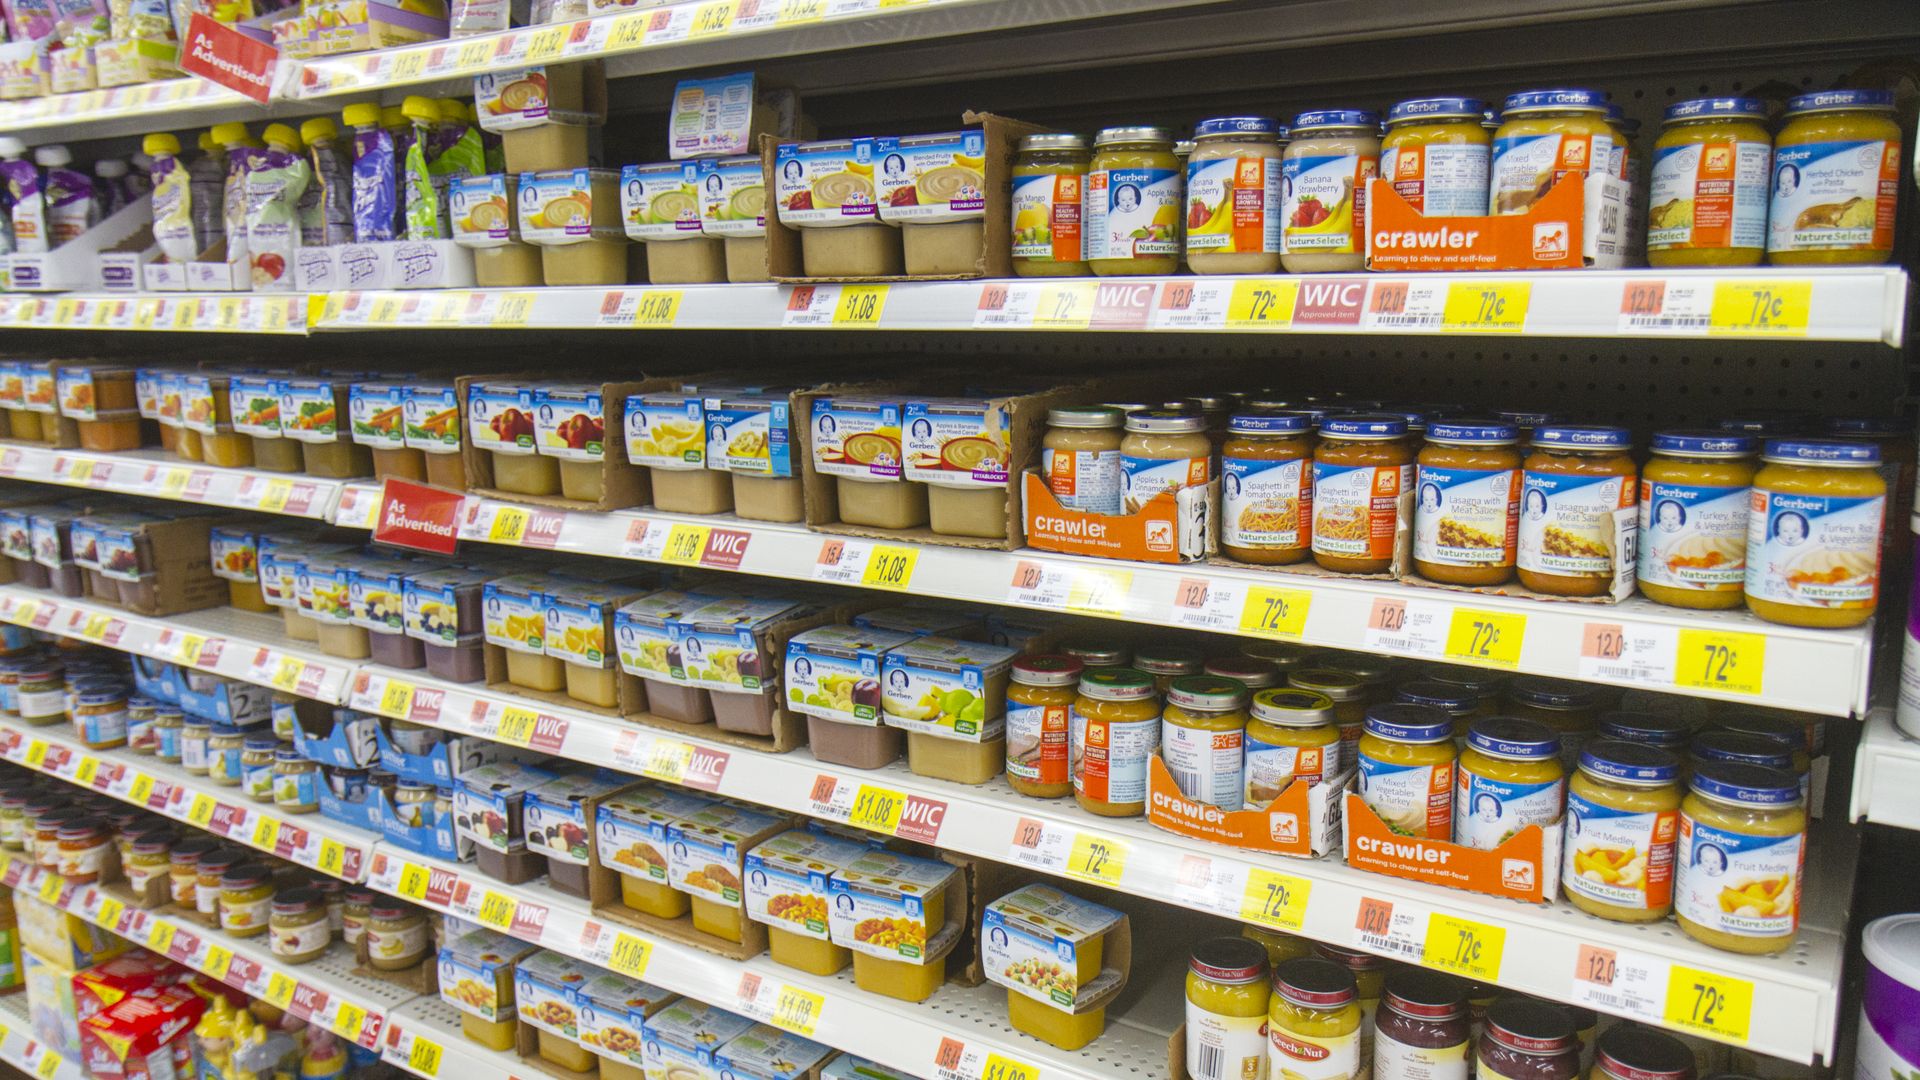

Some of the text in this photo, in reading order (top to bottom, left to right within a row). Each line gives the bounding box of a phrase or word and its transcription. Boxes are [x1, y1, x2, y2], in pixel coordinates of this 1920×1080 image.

[194, 33, 213, 50] As
[191, 47, 267, 88] Advertised
[1556, 93, 1590, 104] Gerber
[1815, 94, 1855, 105] Gerber
[1407, 103, 1440, 113] Gerber
[937, 152, 951, 160] Fruits
[1505, 153, 1529, 163] Mixed
[1777, 151, 1811, 162] Gerber
[1113, 173, 1149, 182] Gerber
[1806, 168, 1864, 178] Herbed Chicken
[882, 178, 910, 187] Gerber
[1303, 176, 1331, 185] Banana
[1699, 181, 1730, 189] NUTRITION
[1824, 178, 1844, 187] Pasta
[782, 183, 807, 192] Gerber
[1298, 184, 1339, 195] Strawberry
[1709, 187, 1730, 195] BABIES
[1374, 226, 1480, 249] crawler
[1374, 254, 1497, 264] Learning to chew and self-feed
[1101, 286, 1149, 308] WIC
[1303, 283, 1361, 308] WIC
[846, 294, 877, 320] $1.08
[1249, 290, 1276, 321] 72¢
[1477, 291, 1506, 321] 72¢
[1750, 291, 1783, 323] 72¢
[1300, 310, 1355, 320] Approved item
[708, 413, 734, 424] Gerber
[1242, 420, 1270, 429] Gerber
[1515, 416, 1545, 425] Gerber
[956, 422, 979, 431] Bananas
[1330, 423, 1358, 432] Gerber
[1434, 427, 1462, 437] Gerber
[816, 436, 839, 445] Gerber
[1572, 433, 1608, 443] Gerber
[909, 440, 936, 451] Gerber
[1702, 441, 1737, 451] Gerber
[1797, 448, 1840, 460] Gerber
[1223, 461, 1248, 472] Gerber
[1136, 475, 1158, 484] Apples
[1420, 470, 1452, 482] Gerber
[1525, 475, 1558, 489] Gerber
[1247, 481, 1290, 492] Spaghetti in
[1320, 487, 1359, 498] Spaghetti in
[1655, 485, 1698, 499] Gerber
[1244, 490, 1294, 499] Tomato Sauce
[1319, 494, 1363, 506] Tomato Sauce
[389, 498, 405, 513] As
[1252, 499, 1287, 508] with Beef
[1449, 496, 1501, 507] Lasagna with
[1554, 502, 1610, 513] Lasagna with
[1773, 496, 1823, 511] Gerber
[1451, 504, 1498, 515] Meat Sauce
[1556, 511, 1579, 521] Meat
[1698, 510, 1730, 522] Turkey,
[386, 514, 453, 537] Advertised
[530, 516, 560, 535] WIC
[1035, 516, 1107, 538] crawler
[1694, 521, 1701, 530] &
[1823, 523, 1856, 534] Turkey,
[710, 535, 744, 554] WIC
[1034, 531, 1060, 542] Learning
[1067, 536, 1083, 544] chew
[1084, 538, 1096, 546] and
[1819, 534, 1826, 543] &
[875, 553, 908, 582] $1.08
[1260, 597, 1289, 629] 72¢
[1379, 605, 1408, 630] 12.0¢
[1469, 621, 1501, 656] 72¢
[1596, 632, 1629, 658] 12.0¢
[1703, 644, 1737, 681] 72¢
[792, 677, 815, 687] Gerber
[416, 690, 442, 709] WIC
[888, 689, 913, 700] Gerber
[537, 718, 567, 738] WIC
[1378, 723, 1408, 737] Gerber
[1499, 743, 1532, 755] Gerber
[692, 756, 728, 776] WIC
[1255, 754, 1274, 766] Mixed
[1594, 760, 1627, 776] Gerber
[1382, 775, 1406, 788] Mixed
[1473, 779, 1512, 796] Gerber
[1374, 784, 1415, 798] Vegetables
[1737, 789, 1776, 802] Gerber
[1378, 793, 1411, 807] & Turkey
[1523, 798, 1547, 809] Mixed
[857, 792, 893, 824] $1.08
[1153, 791, 1225, 825] crawler
[1514, 806, 1553, 818] Vegetables
[902, 801, 944, 828] WIC
[1153, 807, 1214, 833] Learning and
[1519, 817, 1526, 826] &
[898, 823, 935, 837] Approved item
[1583, 825, 1638, 847] Fruit Medley
[1696, 827, 1741, 848] Gerber
[1356, 835, 1452, 865] crawler
[1082, 843, 1111, 875] 72¢
[1356, 854, 1469, 882] Learning to chew and self-feed
[1733, 859, 1790, 873] Fruit Medley
[429, 869, 454, 891] WIC
[1263, 883, 1291, 917] 72¢
[517, 906, 546, 925] WIC
[1457, 929, 1482, 964] 72¢
[1588, 956, 1620, 984] 12.0¢
[1692, 983, 1725, 1025] 72¢
